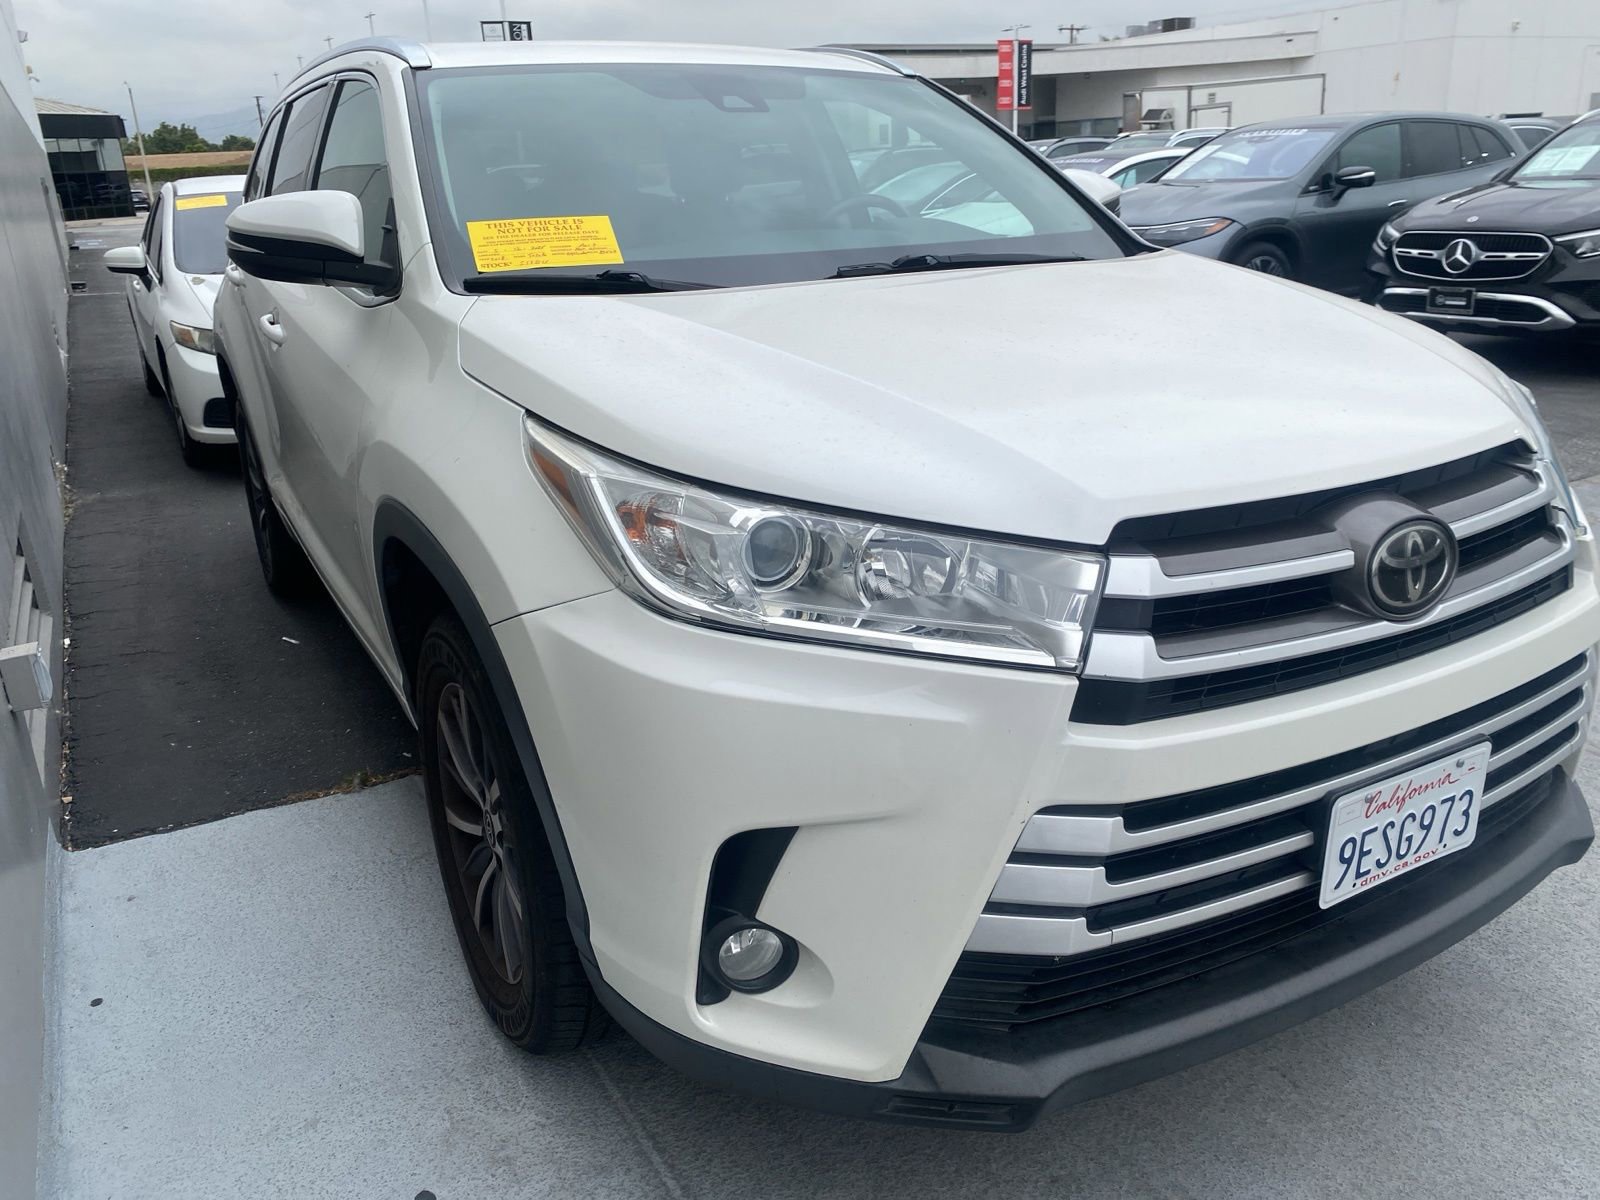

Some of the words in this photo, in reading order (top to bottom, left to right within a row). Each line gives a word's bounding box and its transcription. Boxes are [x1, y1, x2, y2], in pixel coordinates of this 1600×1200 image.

[486, 221, 514, 229] THIS
[518, 218, 570, 227] VEHICLE
[497, 227, 523, 235] NOT
[1364, 768, 1460, 819] California
[1333, 788, 1474, 890] 9ESG973
[1360, 848, 1439, 887] dmv.ca.gov
